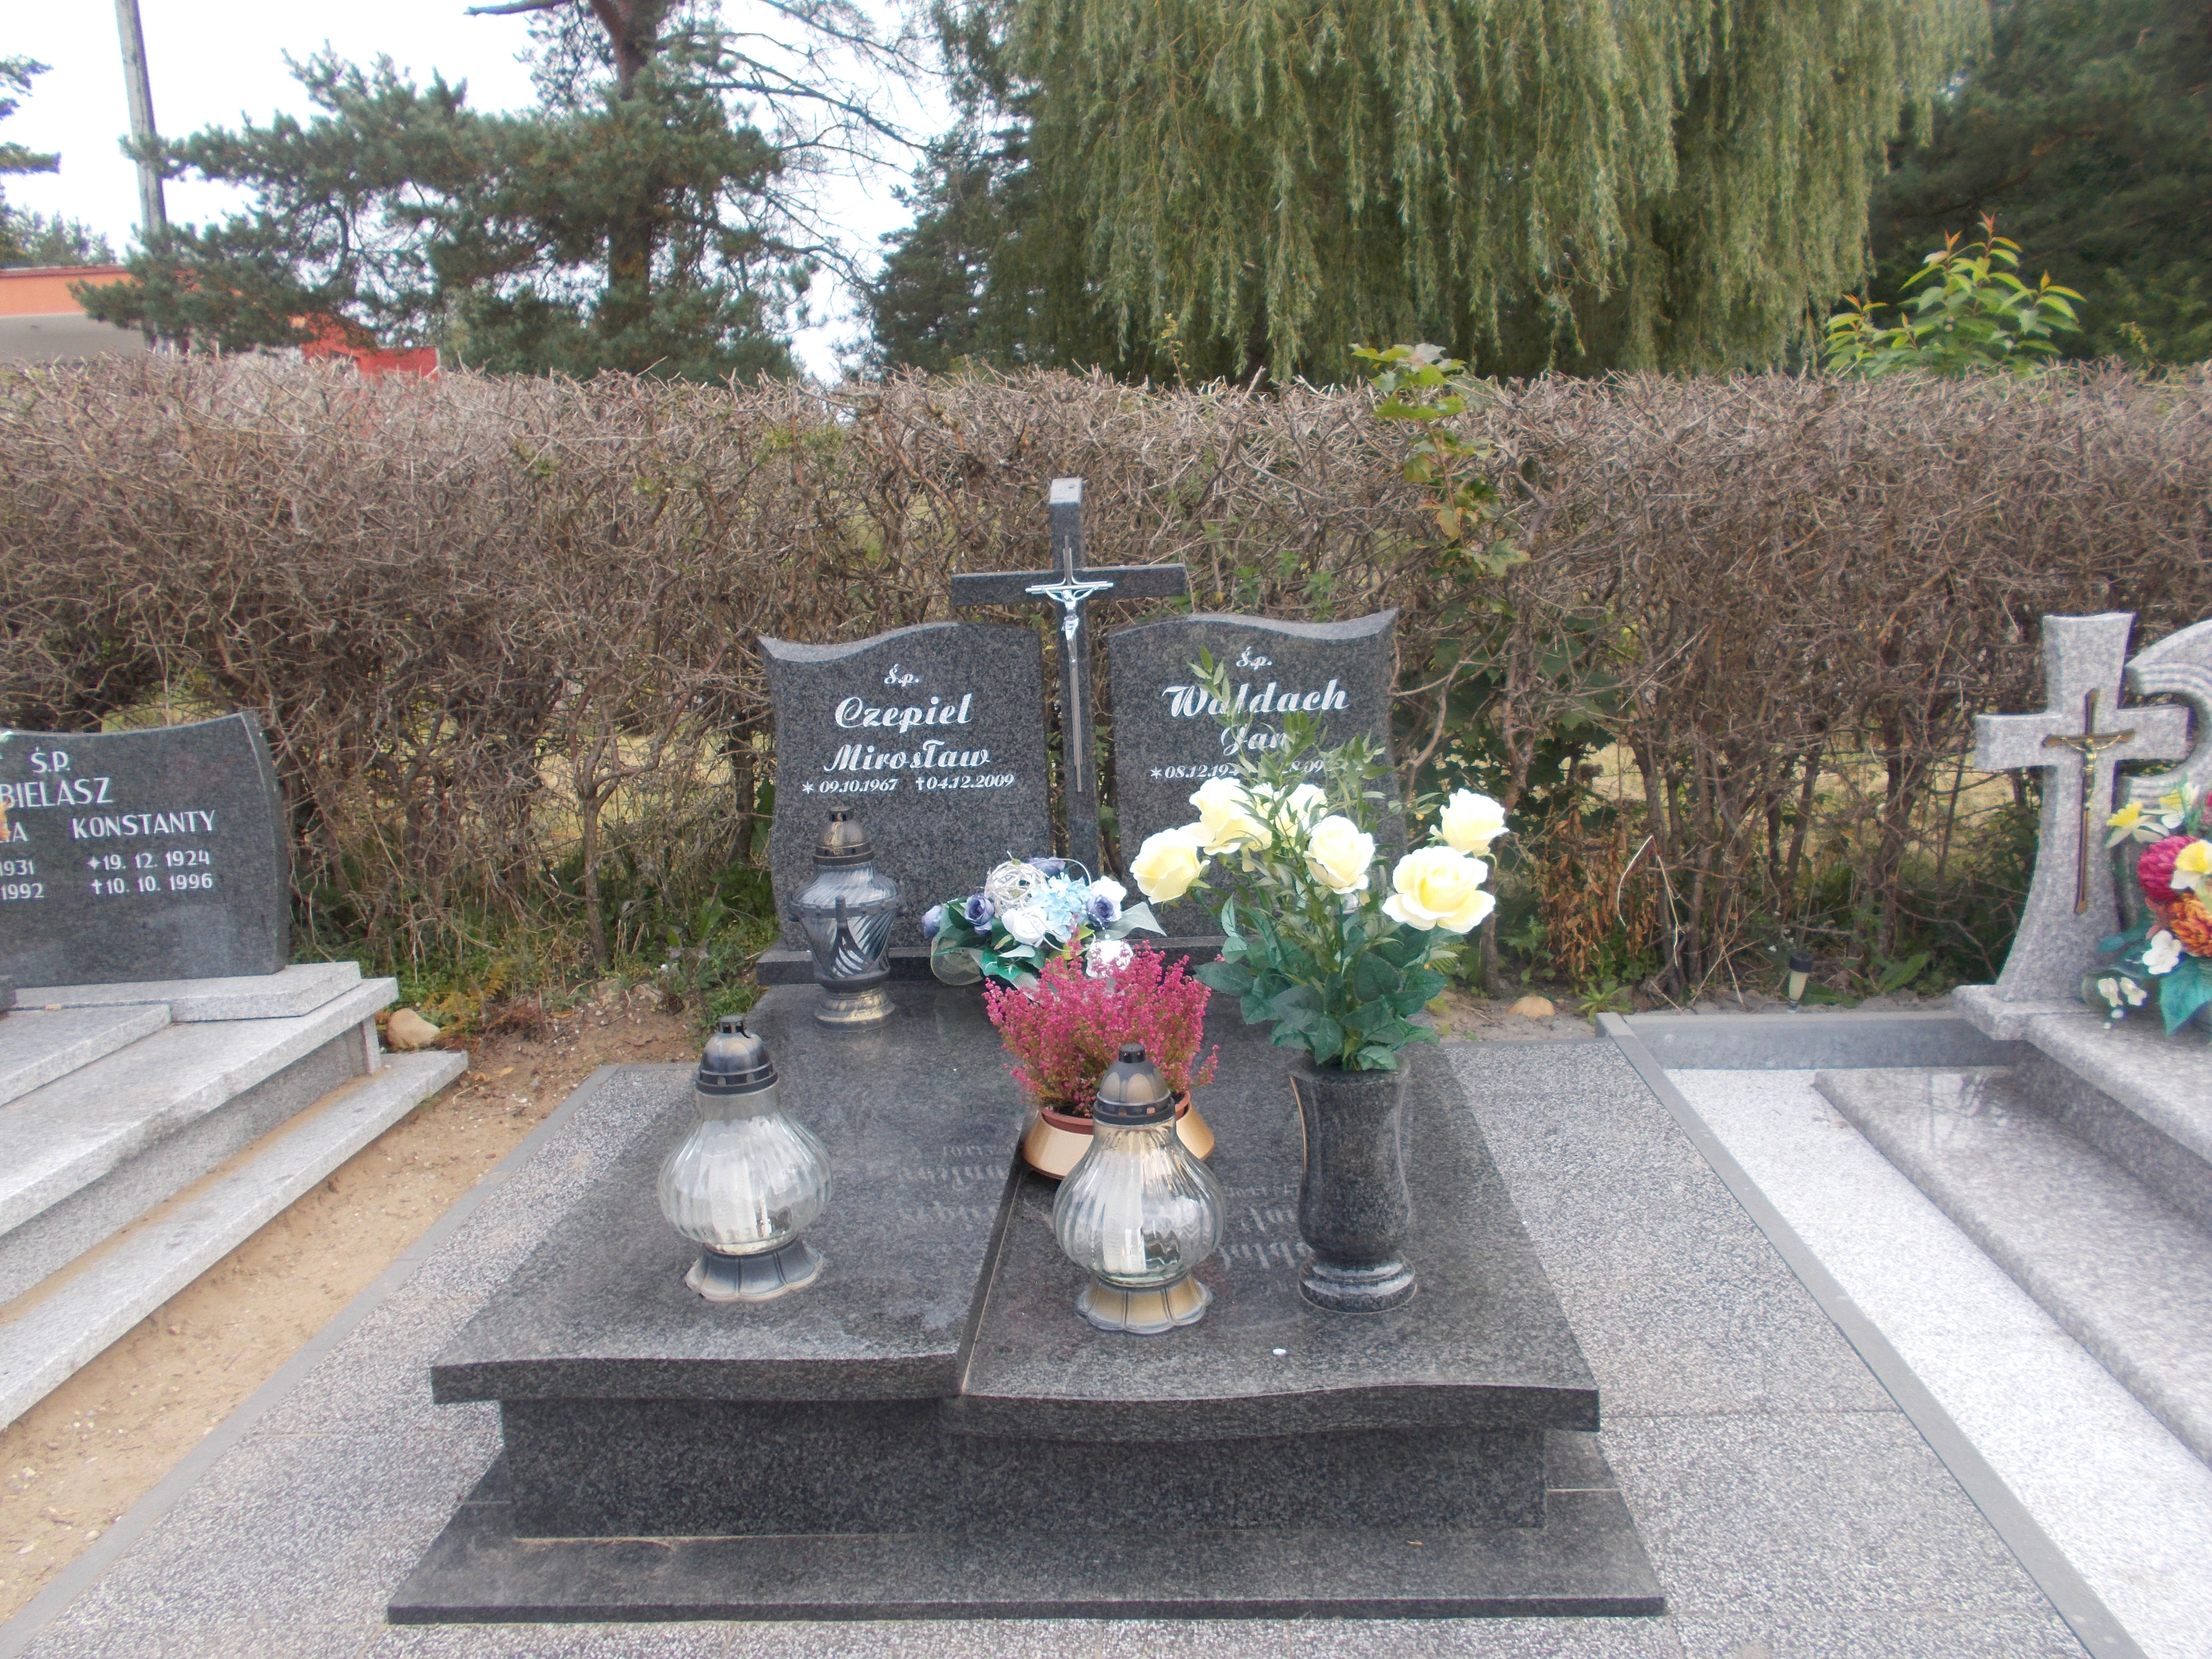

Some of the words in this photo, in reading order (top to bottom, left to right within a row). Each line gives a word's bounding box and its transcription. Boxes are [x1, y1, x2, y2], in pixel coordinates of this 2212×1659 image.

[1161, 679, 1350, 717] Waldach
[835, 693, 972, 733] Czepiel
[1221, 723, 1291, 757] Jan
[823, 739, 991, 771] Mirosław
[819, 778, 898, 793] 09.10.1967
[926, 774, 1014, 791] 04.12.2009
[1165, 763, 1252, 779] 08.12.19
[0, 777, 114, 808] BIELASZ
[72, 810, 215, 839] KONSTANTY
[165, 849, 211, 867] 1924
[1, 882, 44, 900] 1992
[169, 873, 214, 890] 1996
